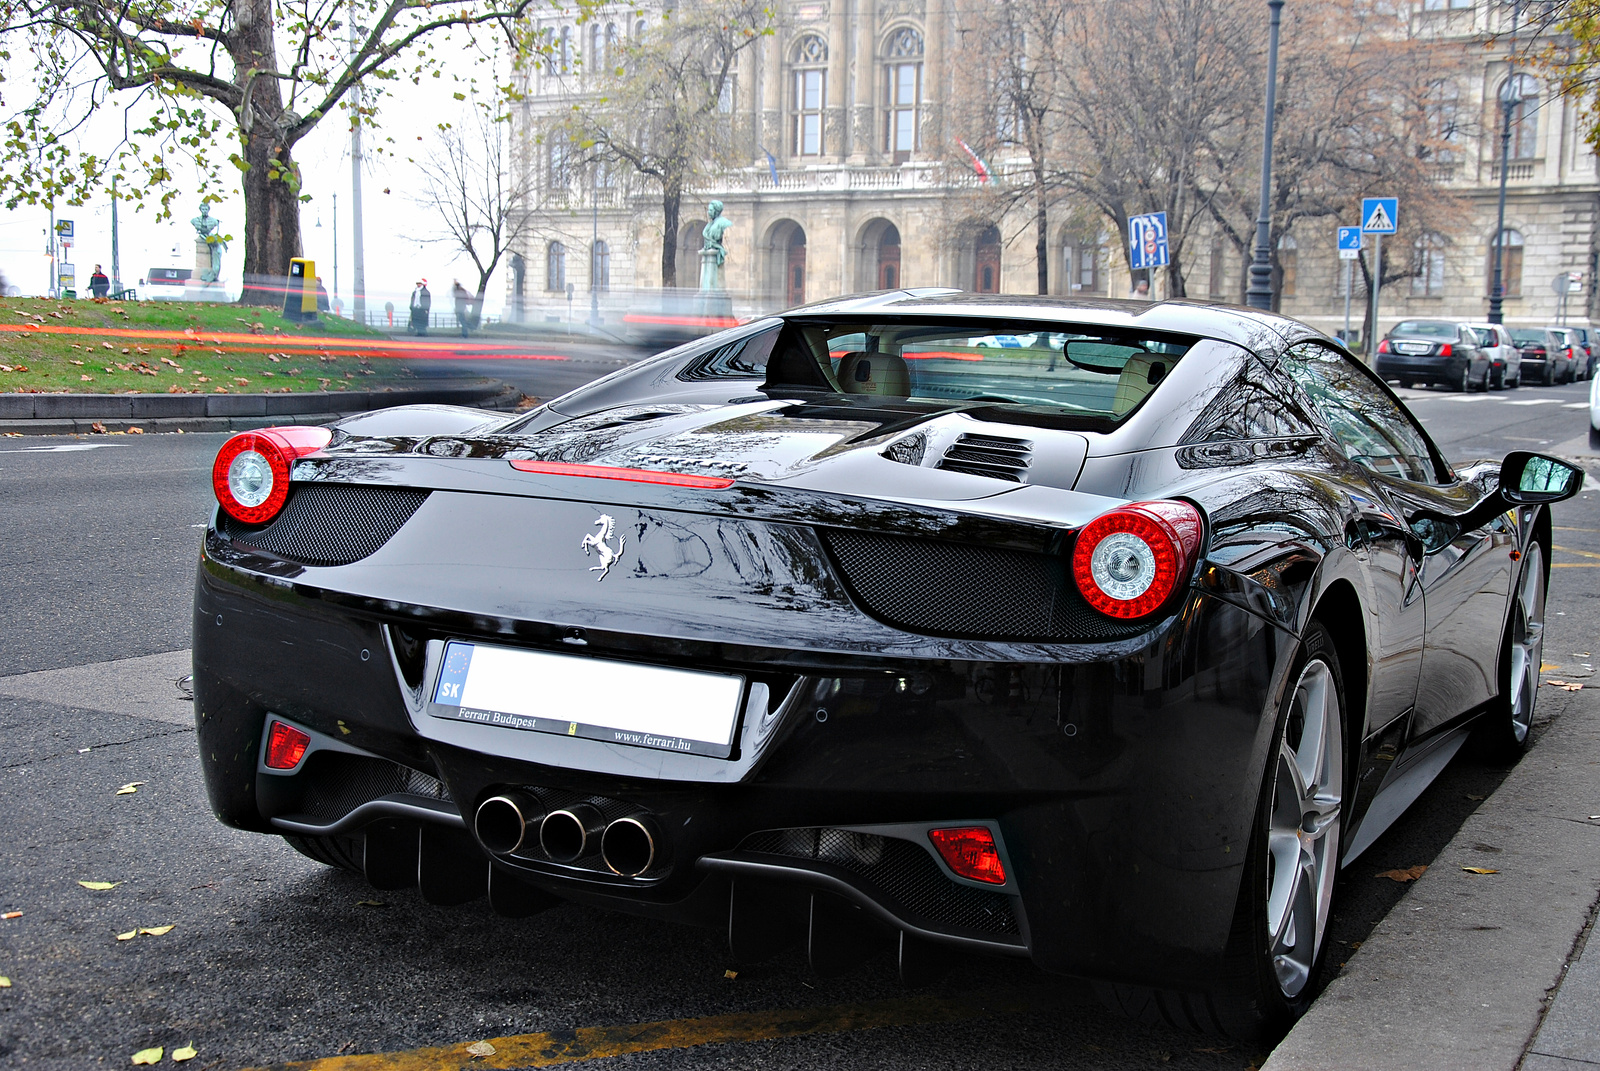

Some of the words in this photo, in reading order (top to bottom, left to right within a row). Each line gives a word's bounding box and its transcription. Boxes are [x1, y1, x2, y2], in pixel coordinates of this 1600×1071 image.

[1340, 229, 1349, 241] P
[441, 682, 460, 699] SK
[458, 707, 491, 721] Ferrari
[492, 712, 537, 728] Budapest
[614, 732, 691, 751] www.ferrari.hu
